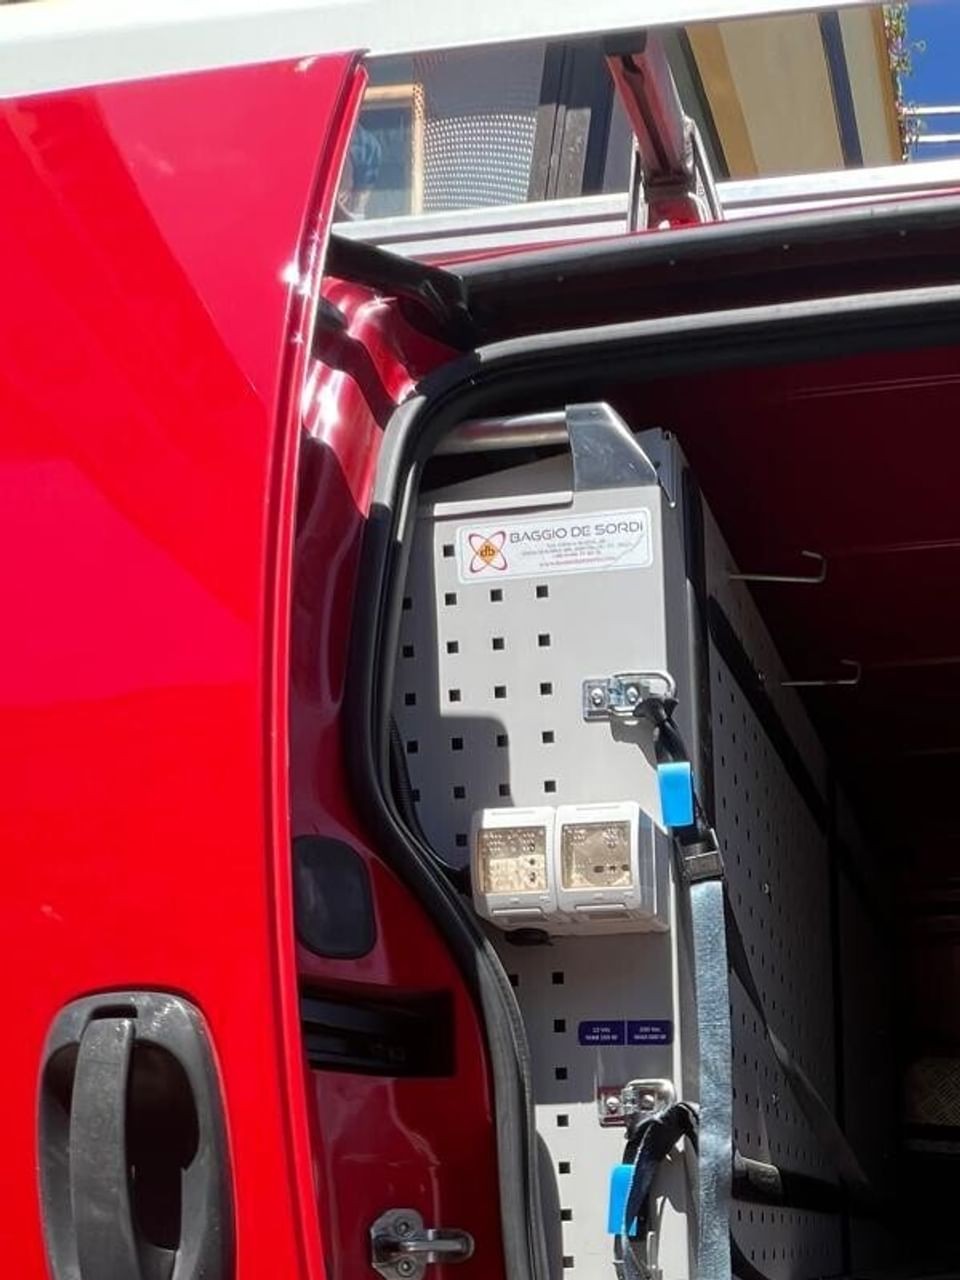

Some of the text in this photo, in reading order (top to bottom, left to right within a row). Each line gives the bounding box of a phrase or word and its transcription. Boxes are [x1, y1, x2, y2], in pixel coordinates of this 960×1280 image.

[509, 521, 644, 544] BAGGIO DE SORDI
